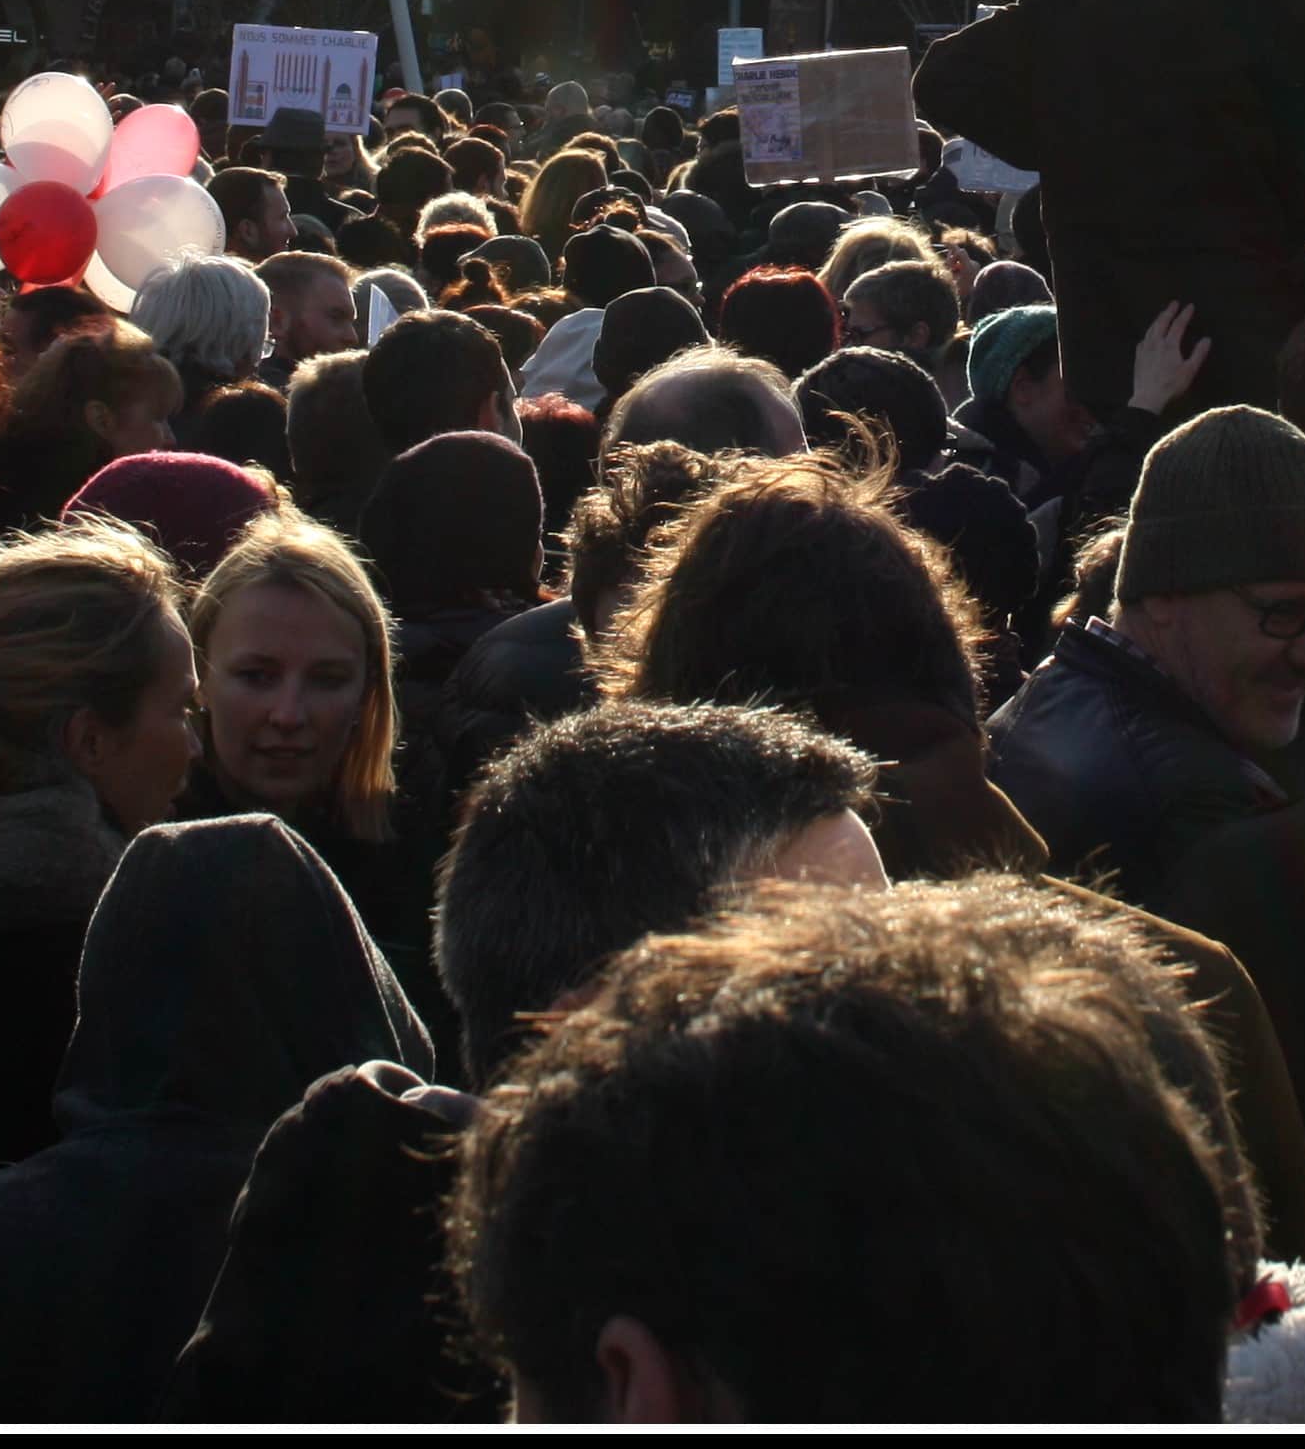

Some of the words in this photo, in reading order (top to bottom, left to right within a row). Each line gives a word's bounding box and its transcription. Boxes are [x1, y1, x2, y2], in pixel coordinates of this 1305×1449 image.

[239, 31, 266, 44] NOUS
[272, 33, 316, 46] SOMMES
[322, 36, 368, 49] CHARLIE
